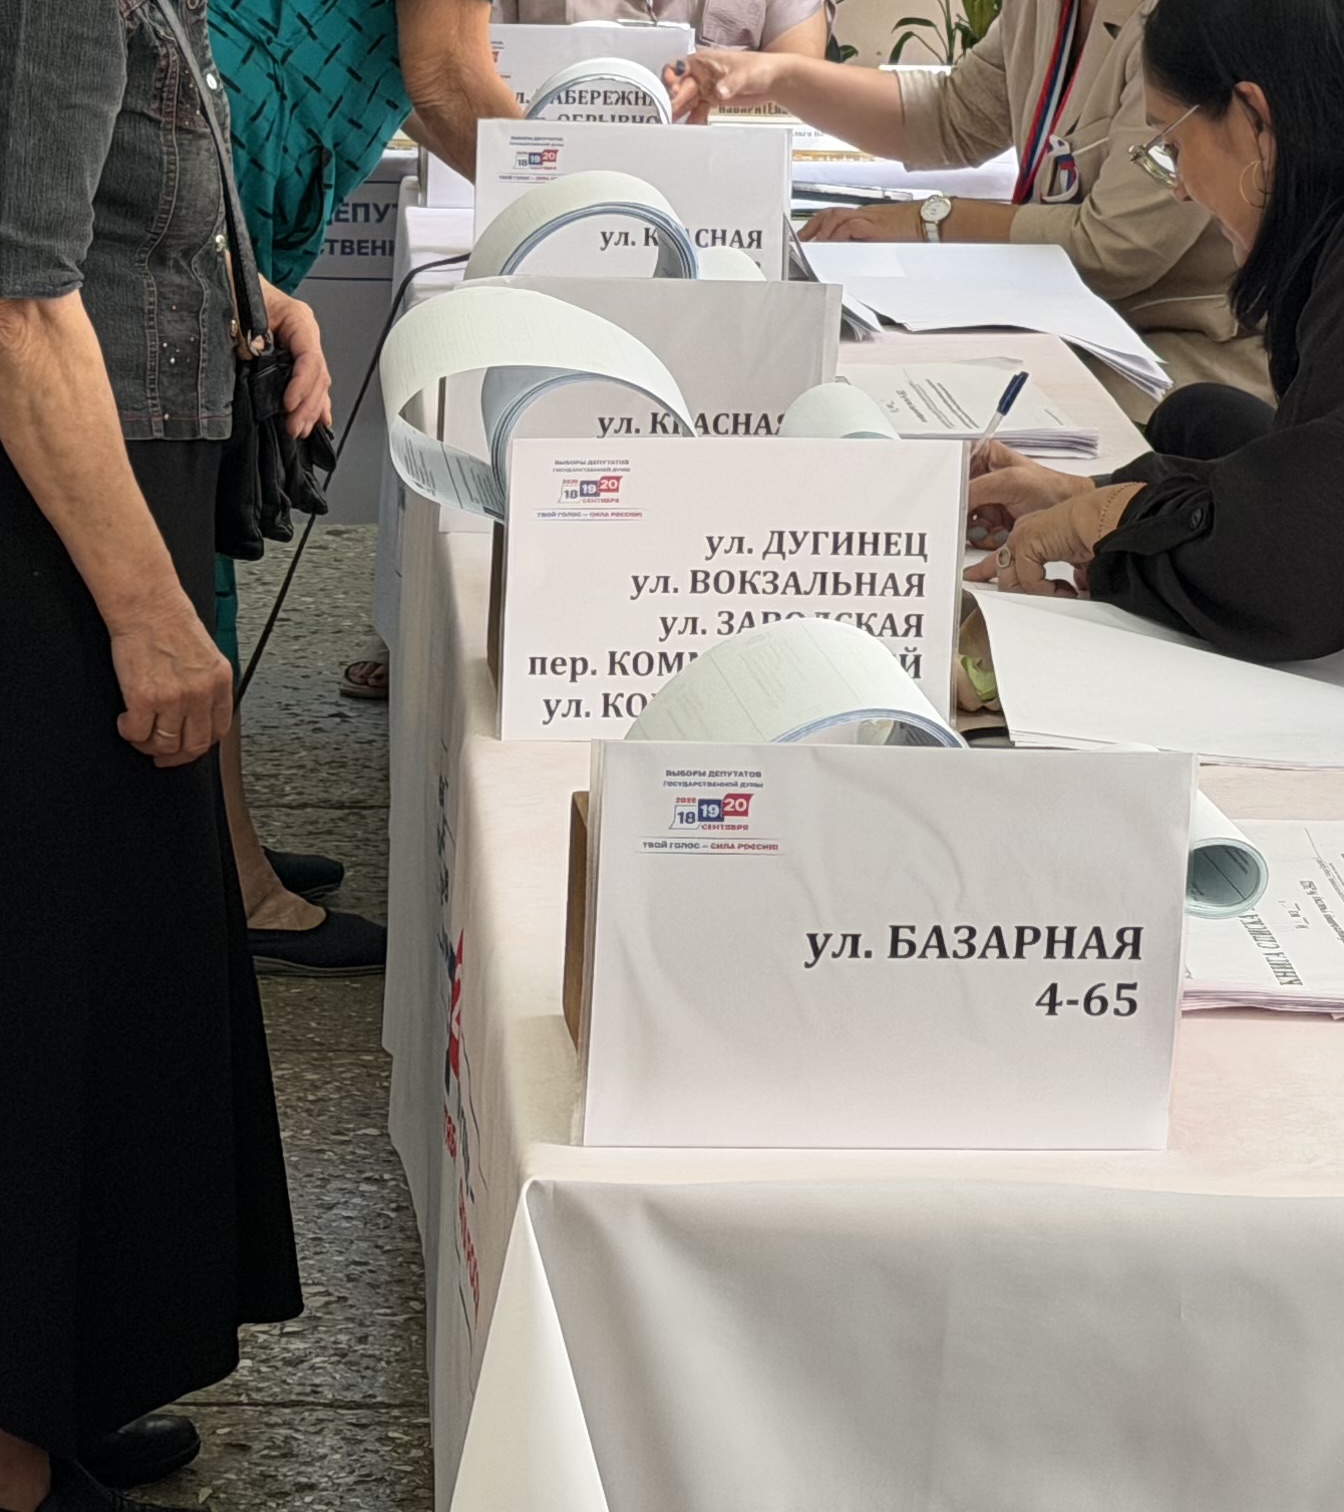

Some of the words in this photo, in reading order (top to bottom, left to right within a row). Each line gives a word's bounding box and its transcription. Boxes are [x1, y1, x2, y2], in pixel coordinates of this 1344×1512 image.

[600, 229, 636, 251] ул.
[704, 534, 754, 561] ул.
[762, 529, 928, 563] ДУГИНЕЦ
[630, 574, 679, 600] ул.
[689, 569, 926, 597] ВОКЗАЛЬНАЯ
[658, 615, 707, 642] ул.
[528, 656, 598, 682] пер.
[542, 698, 591, 724] ул.
[677, 811, 696, 824] 18
[700, 804, 720, 818] 19
[723, 798, 748, 812] 20
[804, 932, 873, 968] ул.
[887, 924, 1144, 960] БАЗАРНАЯ
[1034, 981, 1139, 1017] 4-65
